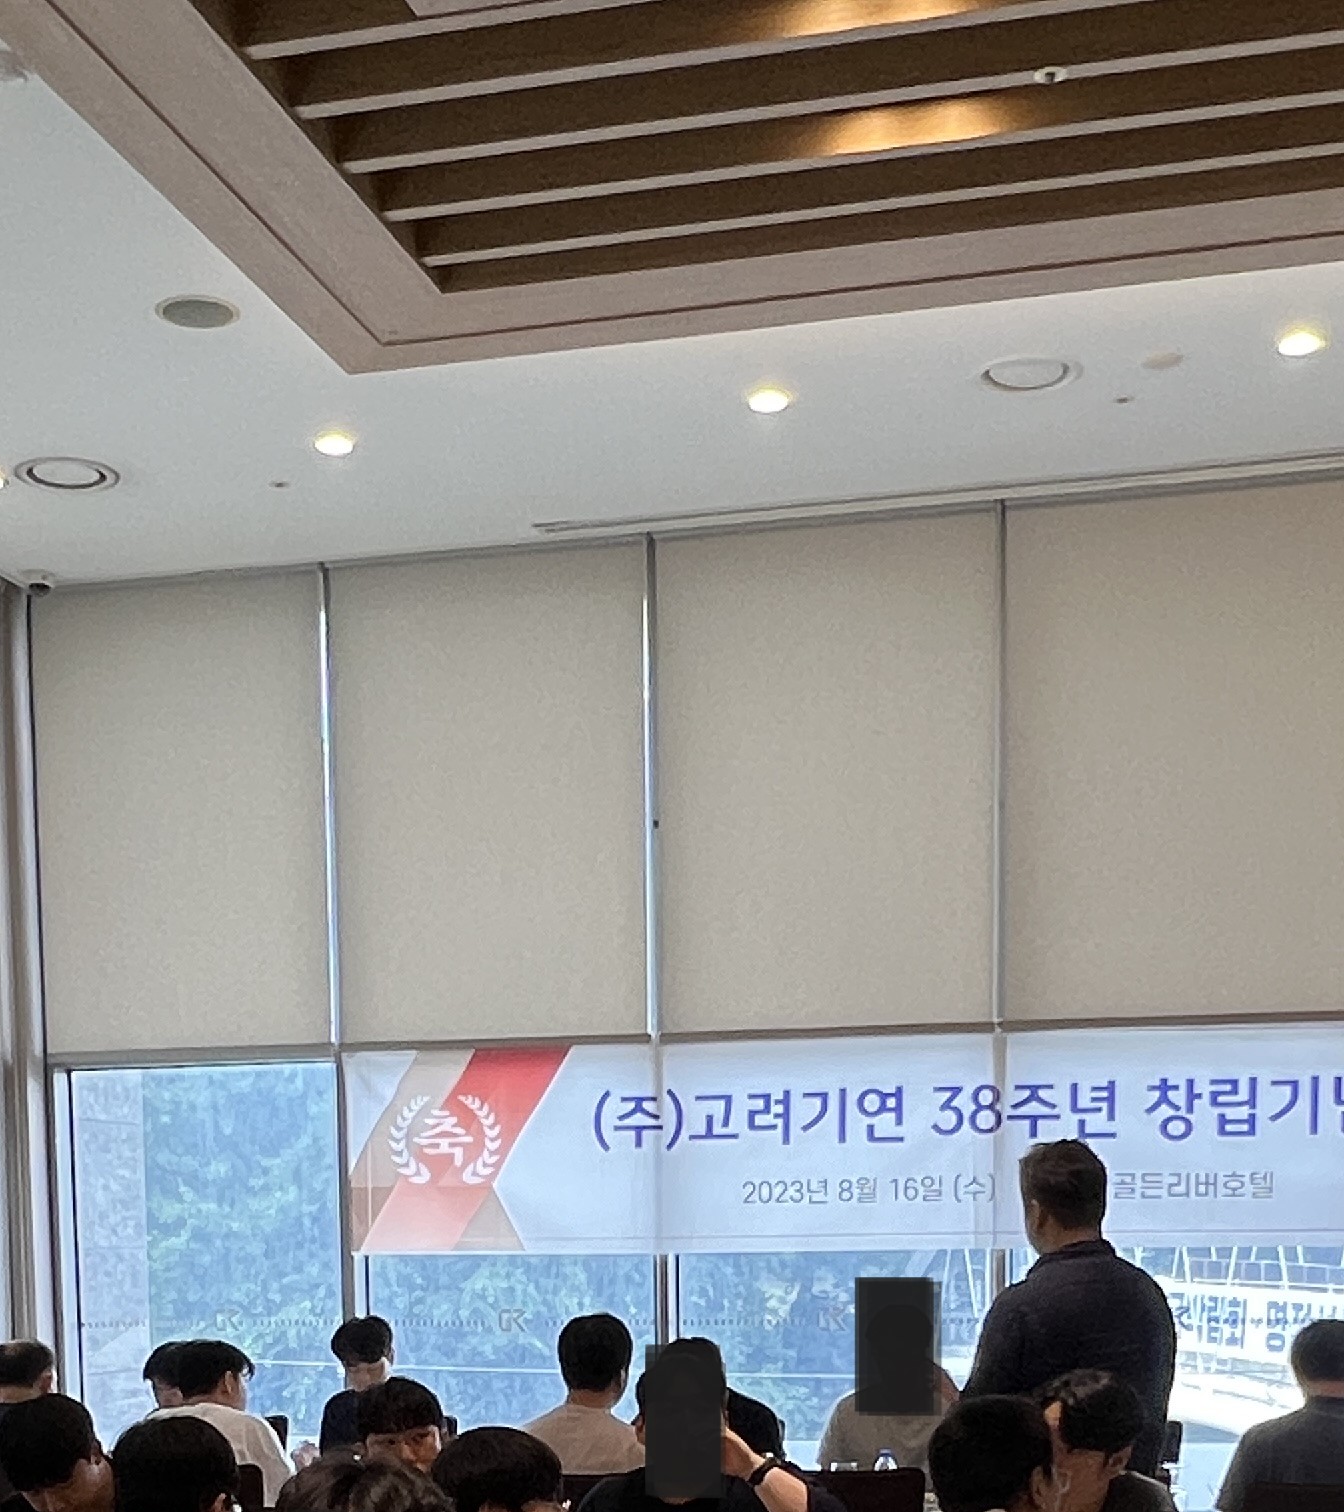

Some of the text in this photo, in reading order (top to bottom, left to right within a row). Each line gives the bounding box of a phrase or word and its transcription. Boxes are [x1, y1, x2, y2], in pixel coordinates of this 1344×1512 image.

[412, 1108, 474, 1167] 축
[593, 1085, 905, 1152] (주)고려기연
[930, 1079, 1118, 1140] 38주년
[741, 1170, 1275, 1205] 2023년 8월 16일 (수) 골든리버호텔
